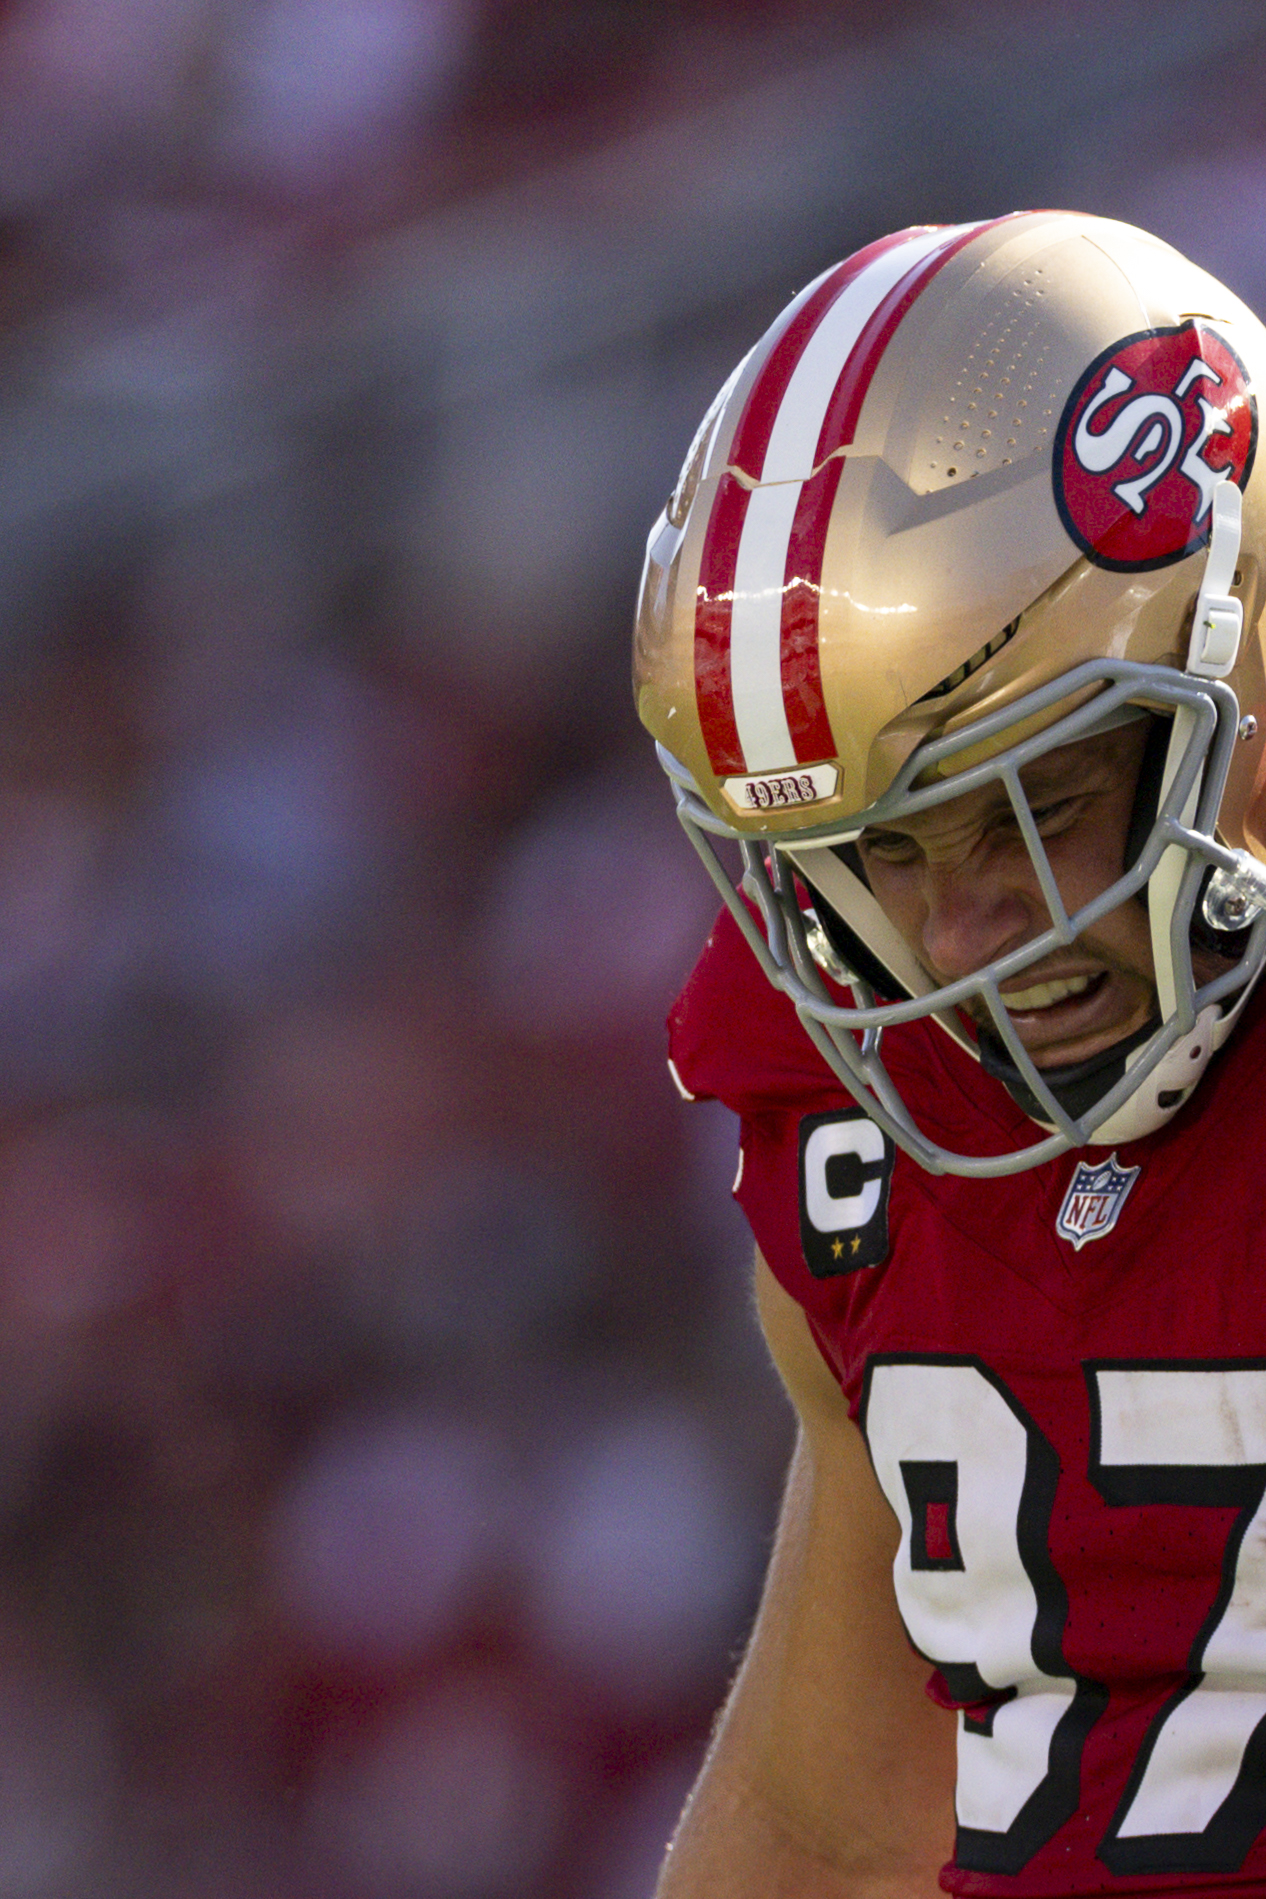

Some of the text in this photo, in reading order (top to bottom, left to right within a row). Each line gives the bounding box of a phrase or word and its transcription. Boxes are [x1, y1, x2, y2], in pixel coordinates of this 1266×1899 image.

[745, 775, 817, 809] 49ERS
[804, 1116, 887, 1234] C
[1065, 1194, 1110, 1230] NFL
